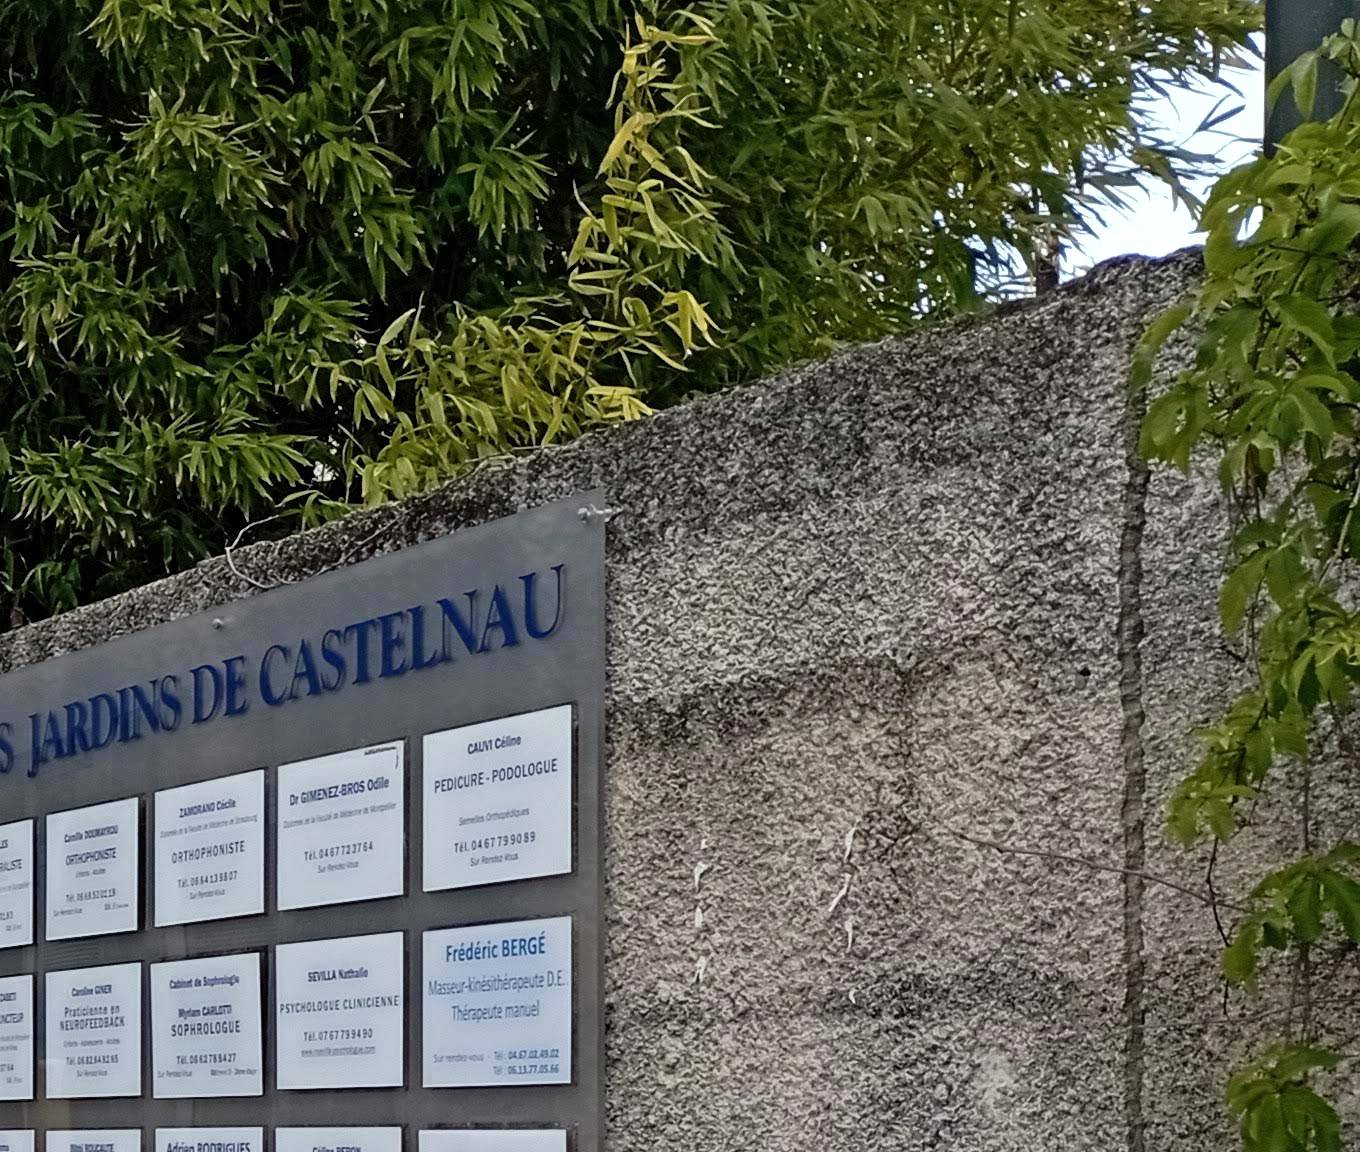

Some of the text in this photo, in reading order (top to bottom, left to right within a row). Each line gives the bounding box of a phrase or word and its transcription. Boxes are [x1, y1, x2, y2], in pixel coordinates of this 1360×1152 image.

[27, 673, 181, 778] JARDINS
[190, 655, 248, 726] DE
[260, 563, 565, 706] CASTELNAU
[494, 732, 521, 749] Céline
[434, 771, 484, 793] PEDICURE
[492, 757, 557, 783] PODOLOGUE
[171, 839, 244, 864] ORTHOPHONISTE
[446, 930, 545, 962] Frédéric BERGÉ
[280, 995, 399, 1014] PSYCHOLOGUE CLINICIENNE
[451, 999, 539, 1024] Thérapeute manuel
[59, 1015, 124, 1031] NEUROFEEDBACK
[171, 1019, 240, 1036] SOPHROLOGUE
